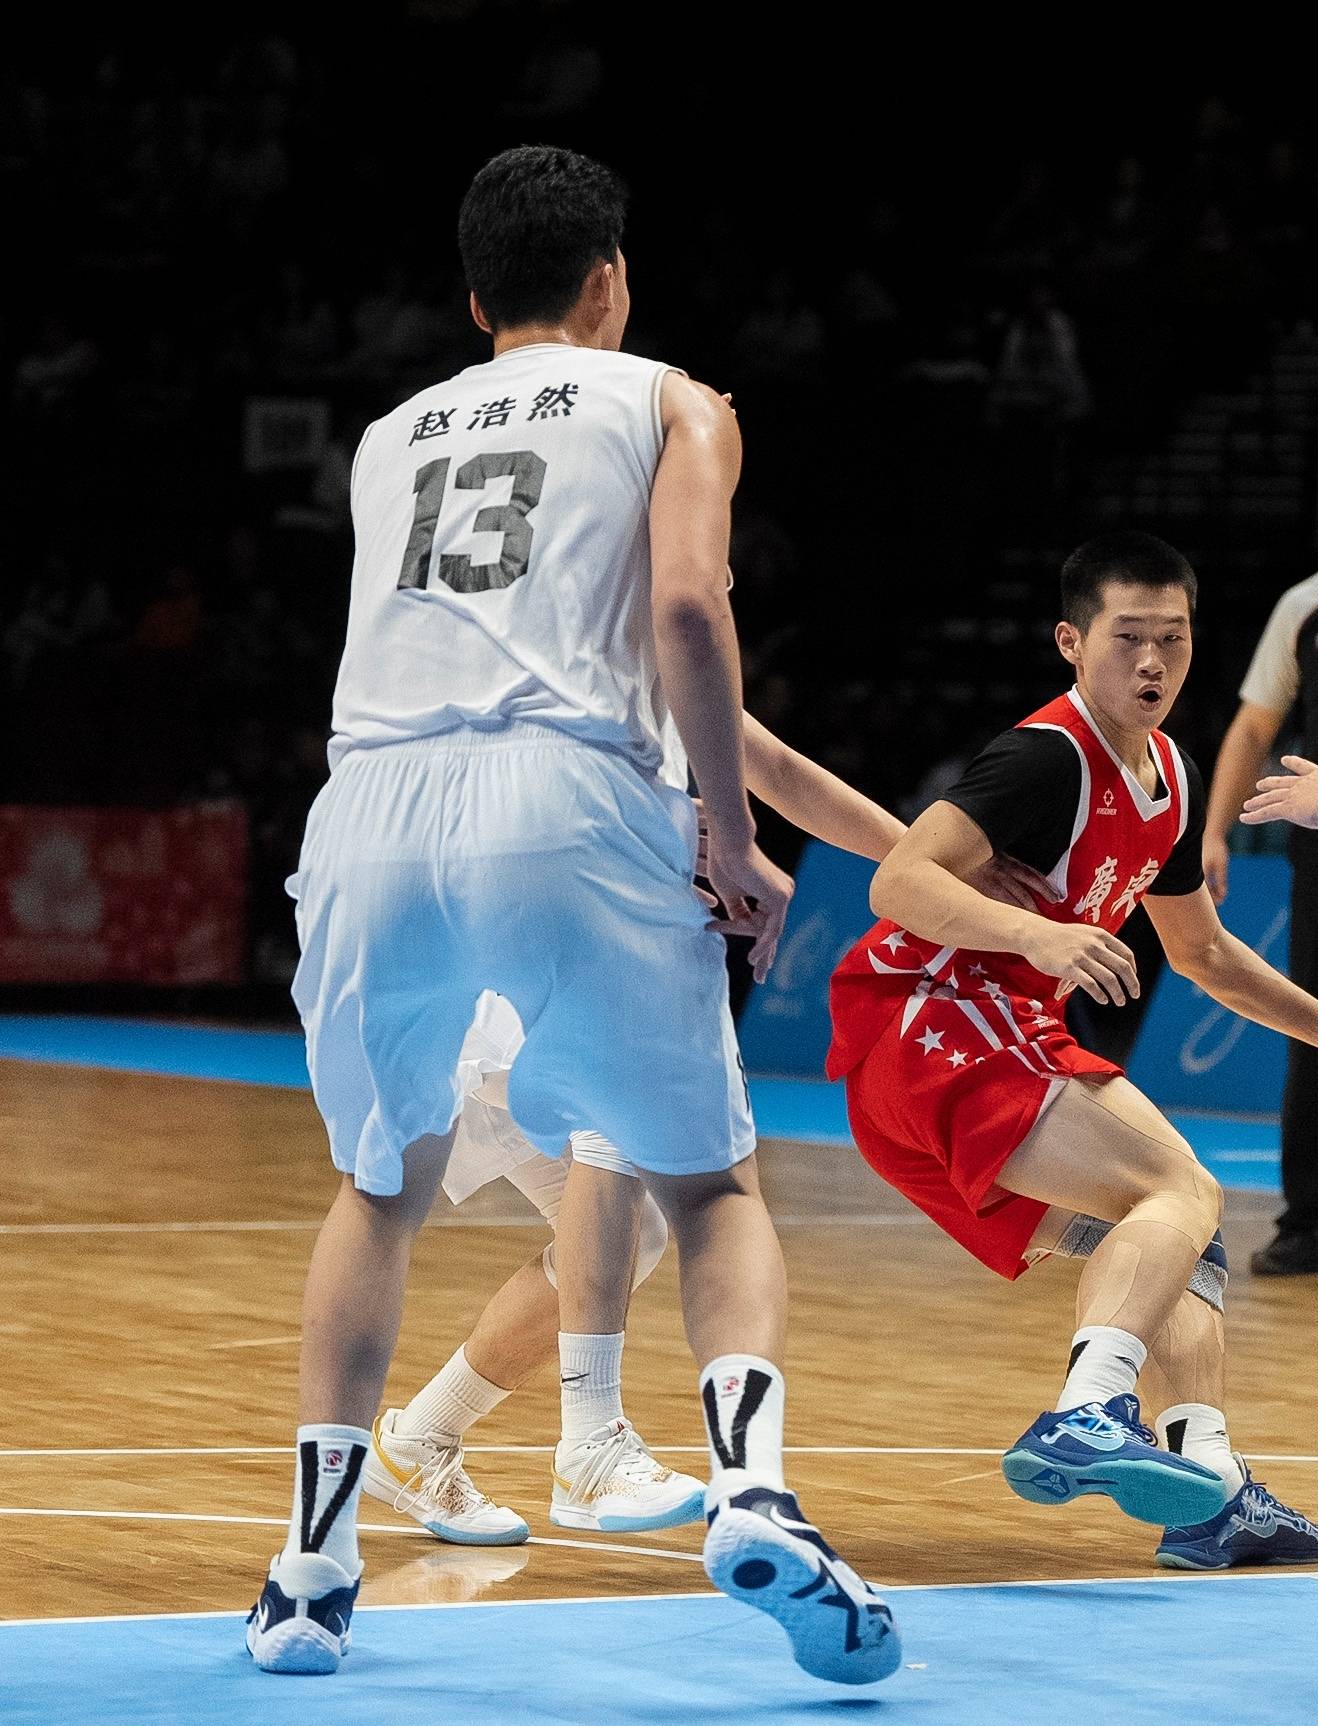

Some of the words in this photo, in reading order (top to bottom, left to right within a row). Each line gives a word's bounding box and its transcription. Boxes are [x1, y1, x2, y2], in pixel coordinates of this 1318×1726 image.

[408, 383, 579, 447] 赵浩然
[396, 450, 548, 593] 13
